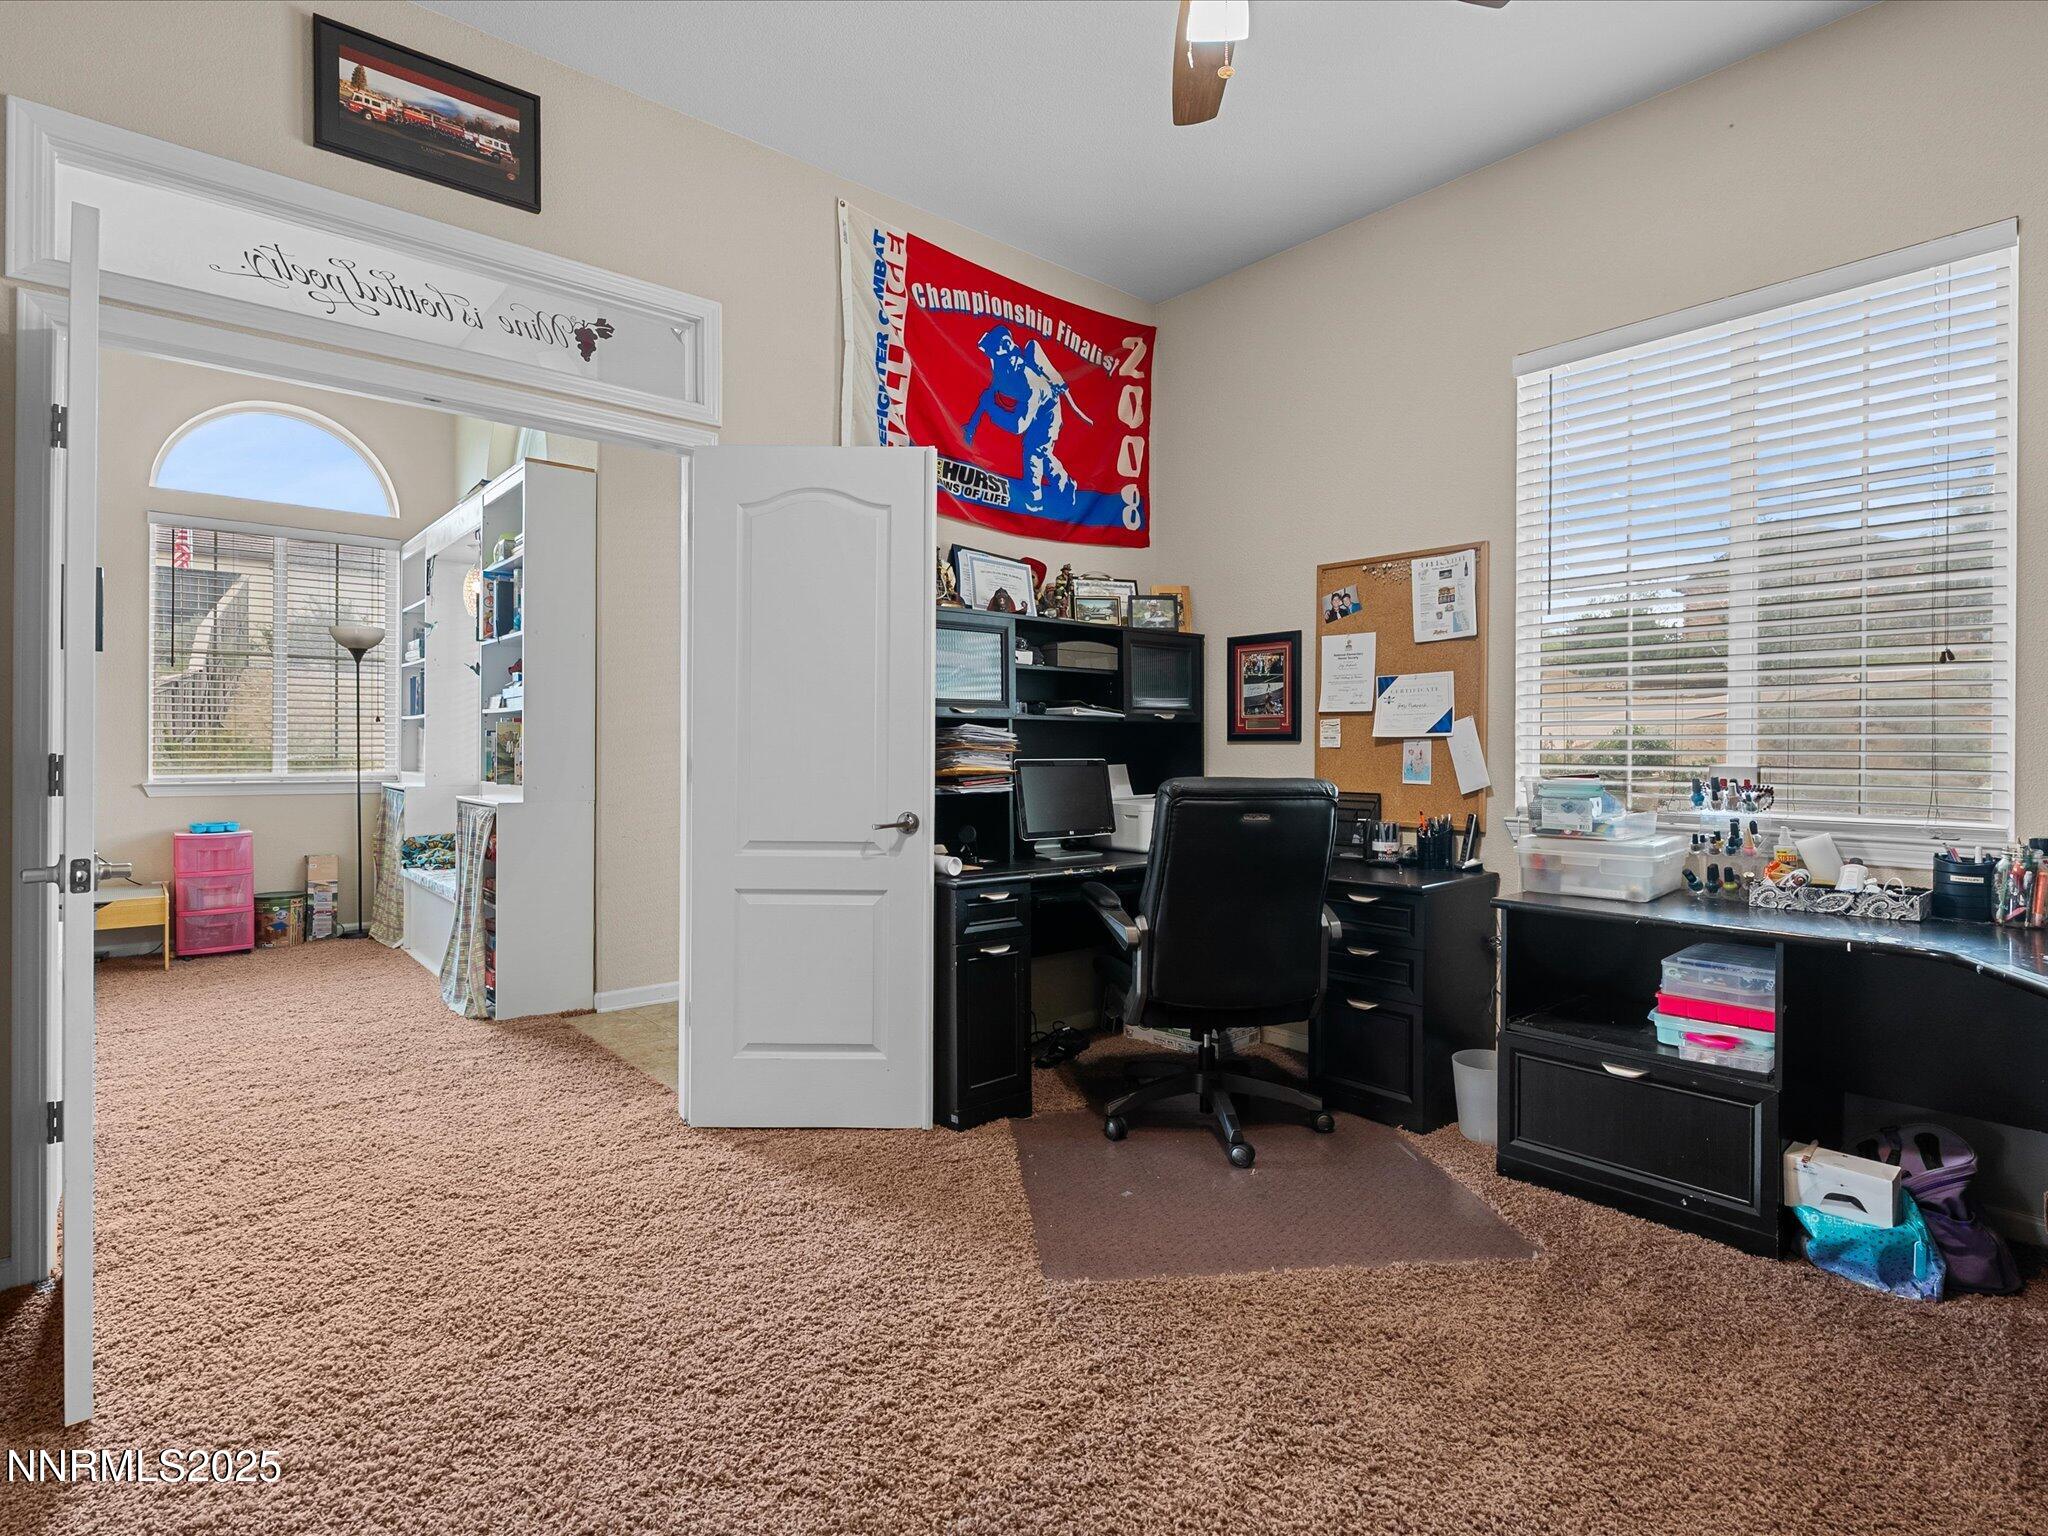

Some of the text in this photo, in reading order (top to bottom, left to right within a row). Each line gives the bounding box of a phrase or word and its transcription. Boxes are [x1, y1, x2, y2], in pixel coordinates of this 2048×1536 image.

[911, 282, 1053, 338] Championship
[1117, 336, 1148, 531] 2008
[942, 460, 1009, 495] HURST
[964, 486, 980, 498] OF
[983, 491, 1008, 505] LIFE
